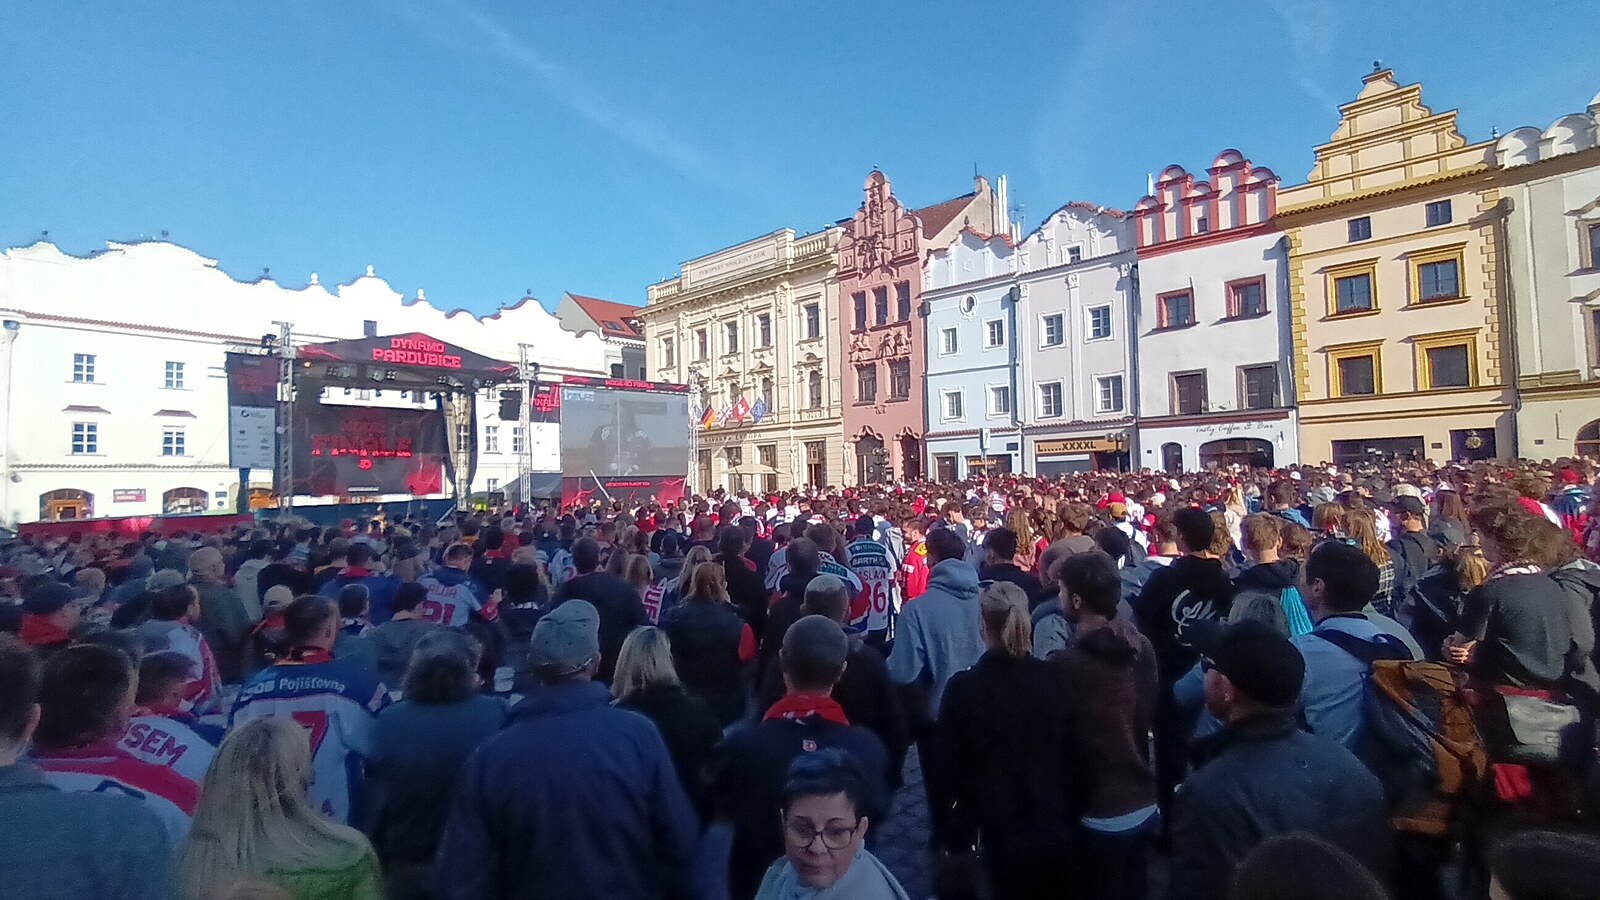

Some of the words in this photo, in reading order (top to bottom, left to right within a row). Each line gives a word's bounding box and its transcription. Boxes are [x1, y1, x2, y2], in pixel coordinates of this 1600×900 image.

[390, 338, 446, 353] DYNAMO
[372, 348, 462, 368] PARDUBICE
[1218, 423, 1240, 435] Coffee
